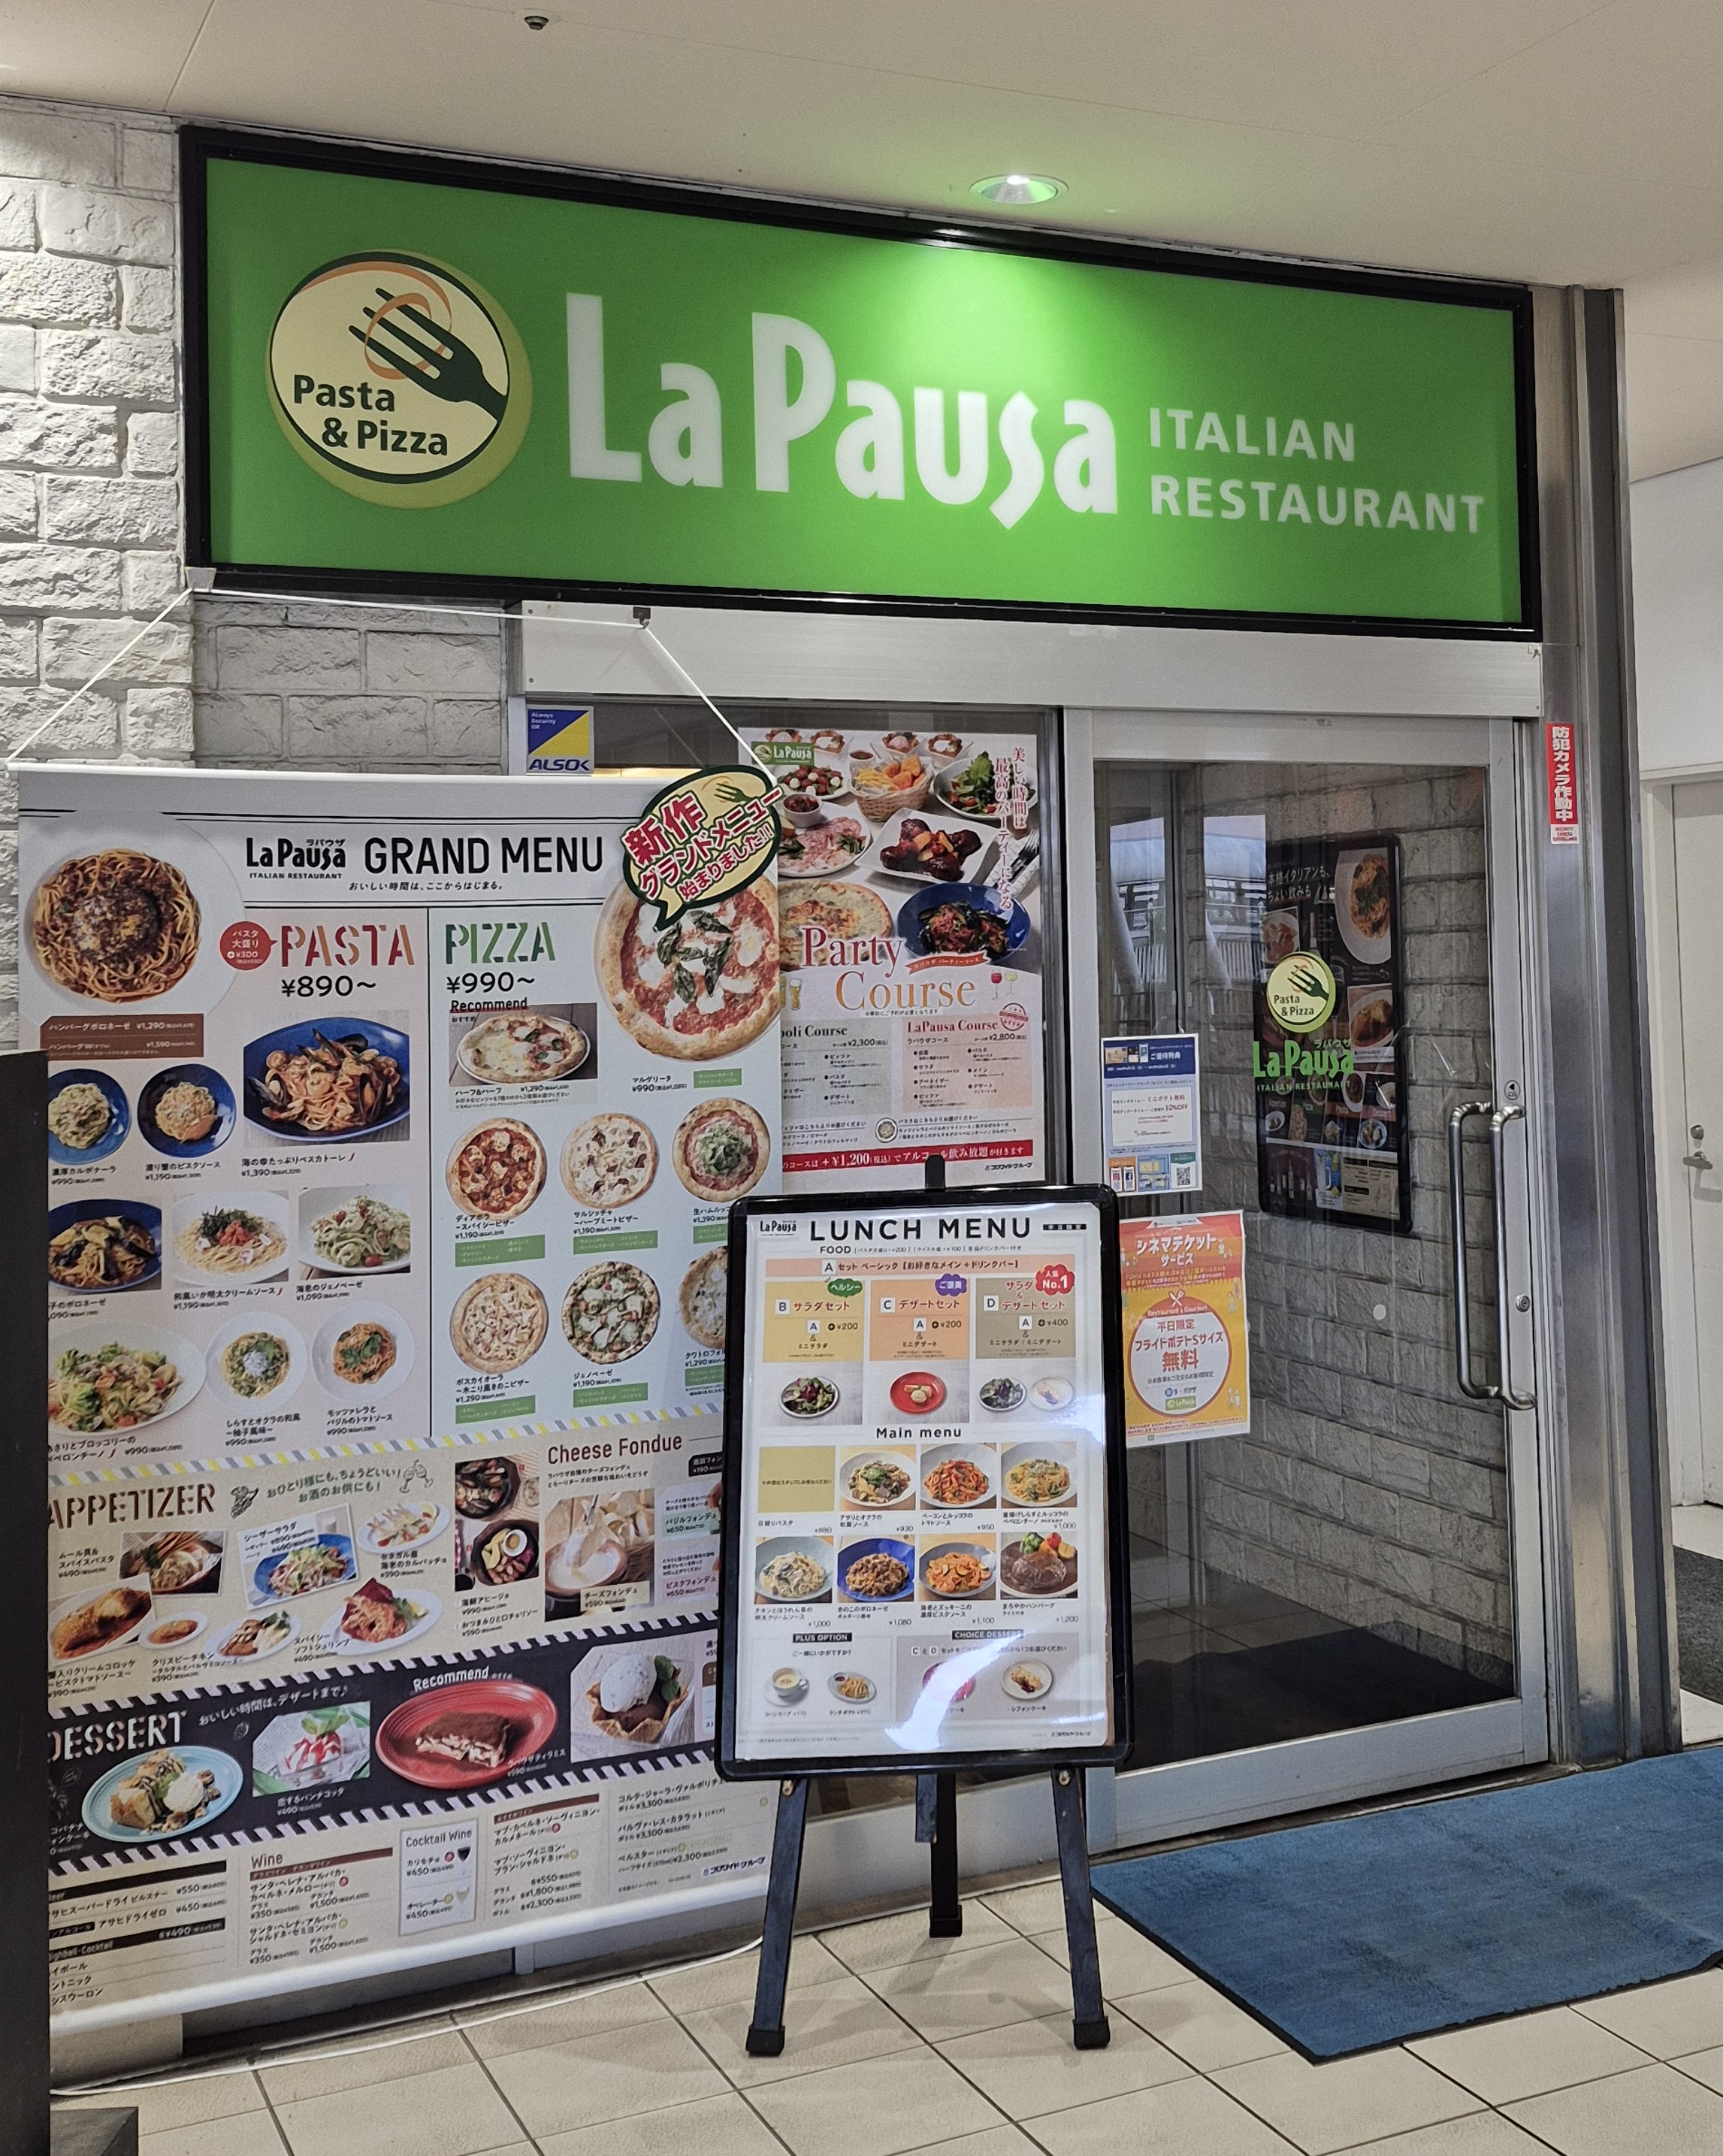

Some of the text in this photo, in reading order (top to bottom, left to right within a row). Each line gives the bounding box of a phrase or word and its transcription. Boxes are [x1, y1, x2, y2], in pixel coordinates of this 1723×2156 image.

[293, 374, 395, 414] Pasta
[566, 292, 1118, 530] La Pausa
[322, 417, 449, 457] & Pizza
[1150, 407, 1355, 463] ITALIAN
[1150, 476, 1485, 534] RESTAURANT
[528, 758, 591, 771] ALSOK
[1552, 726, 1573, 822] 防犯カメラ作動中
[1011, 747, 1028, 830] 美しい時間は
[623, 794, 704, 867] 新作
[993, 757, 1014, 911] 最高のパーティーになる
[640, 786, 783, 900] グランドメニュー
[246, 837, 346, 871] La Pausa
[365, 836, 603, 875] GRAND MENU
[232, 930, 259, 938] パスタ
[231, 939, 259, 949] 大盛り
[281, 924, 415, 967] PASTA
[446, 922, 556, 966] PIZZA
[801, 927, 903, 978] Party
[835, 970, 976, 1011] Course
[451, 996, 528, 1012] Recommend
[1274, 994, 1301, 1005] Pasta
[1281, 1005, 1314, 1017] & Pizza
[804, 1024, 848, 1038] Course
[957, 1019, 999, 1031] Course
[1253, 1040, 1353, 1078] La Pausa
[632, 1075, 672, 1084] マルゲリータ
[1257, 1080, 1351, 1092] ITALIAN RESTAURANT
[810, 1217, 1031, 1241] LUNCH MENU
[820, 1245, 851, 1254] FOOD
[824, 1262, 899, 1272] A セット ベーシック
[1160, 1252, 1193, 1267] サービス
[830, 1284, 861, 1292] ヘルシー
[1005, 1281, 1034, 1290] サラダ
[1042, 1275, 1069, 1290] No.1
[778, 1300, 851, 1312] B サラダセット
[883, 1299, 960, 1310] C デザートセット
[987, 1298, 1066, 1311] D デザート セット
[836, 1322, 859, 1330] ¥200
[940, 1320, 962, 1329] ¥200
[1047, 1318, 1069, 1326] ¥400
[1156, 1319, 1195, 1332] 平日限定
[1135, 1331, 1224, 1352] フライドポテトSサイズ
[1162, 1347, 1199, 1373] 無料
[876, 1426, 961, 1439] Main menu
[548, 1434, 682, 1465] Cheese Fondue
[48, 1483, 216, 1529] APPETIZER
[795, 1634, 848, 1642] PLUS OPTION
[954, 1631, 984, 1639] CHOICE
[413, 1665, 490, 1692] Recommend
[406, 1828, 472, 1848] Cocktail Wine
[251, 1853, 283, 1870] Wine
